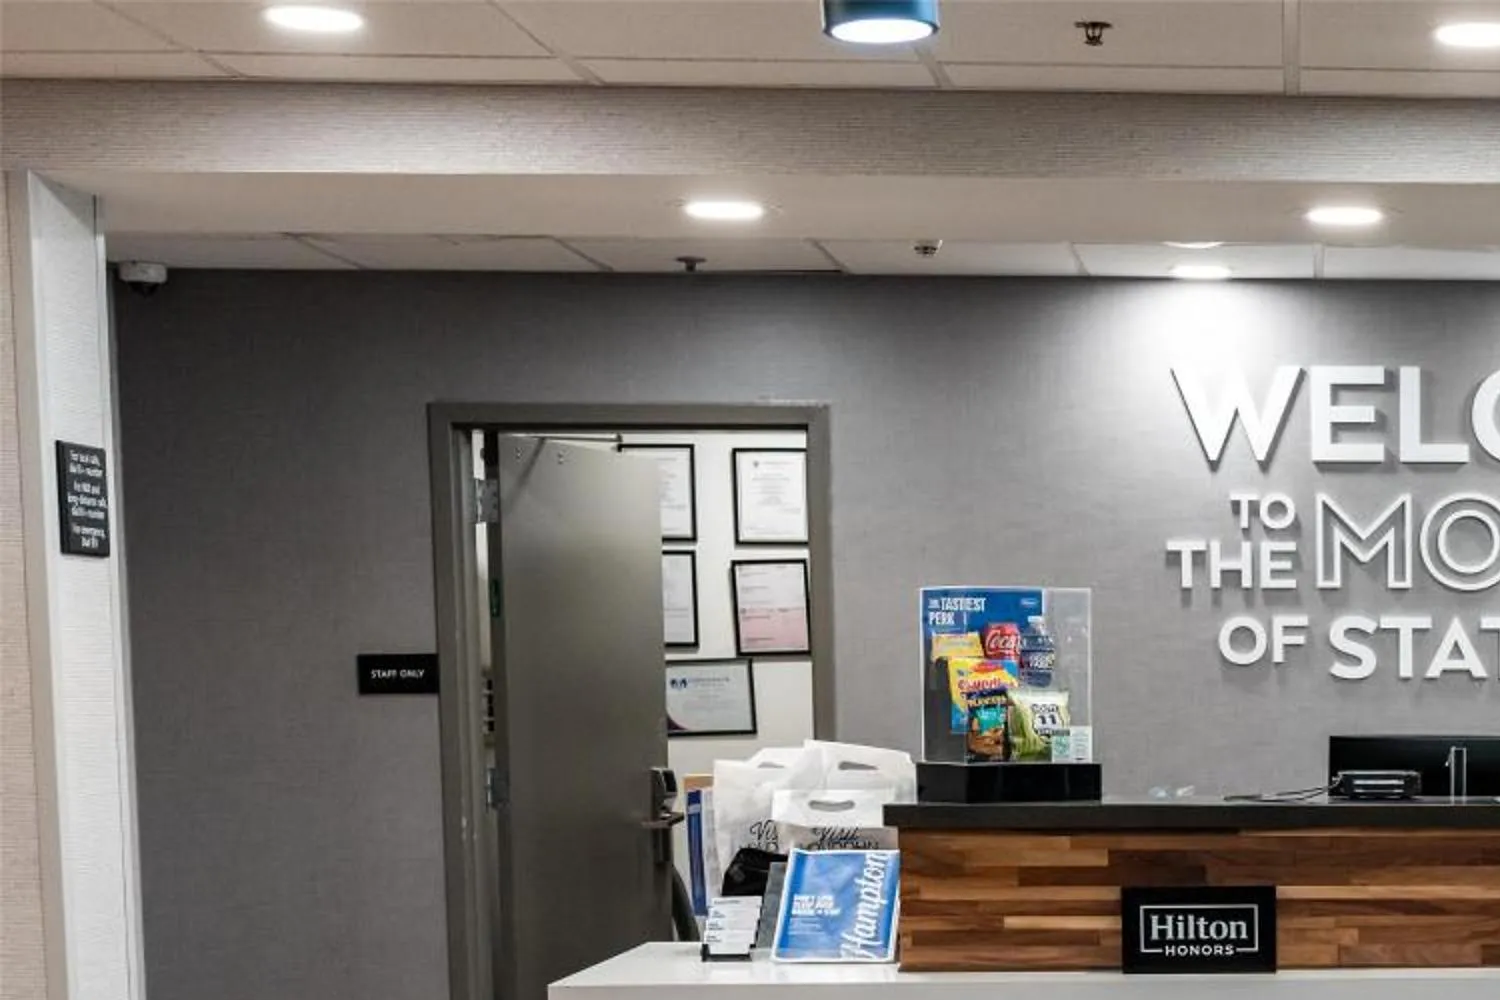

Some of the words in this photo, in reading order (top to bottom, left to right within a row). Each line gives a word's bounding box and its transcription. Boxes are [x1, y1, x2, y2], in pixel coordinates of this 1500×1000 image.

[1230, 493, 1295, 530] TO
[1167, 540, 1297, 589] THE
[941, 597, 987, 611] TASTIEST
[928, 612, 955, 625] PERK
[1219, 616, 1309, 665] OF
[371, 669, 397, 679] STAFF
[400, 669, 424, 680] ONLY
[840, 852, 890, 958] Hampton
[1150, 914, 1248, 940] Hilton
[1165, 944, 1235, 957] HONORS
